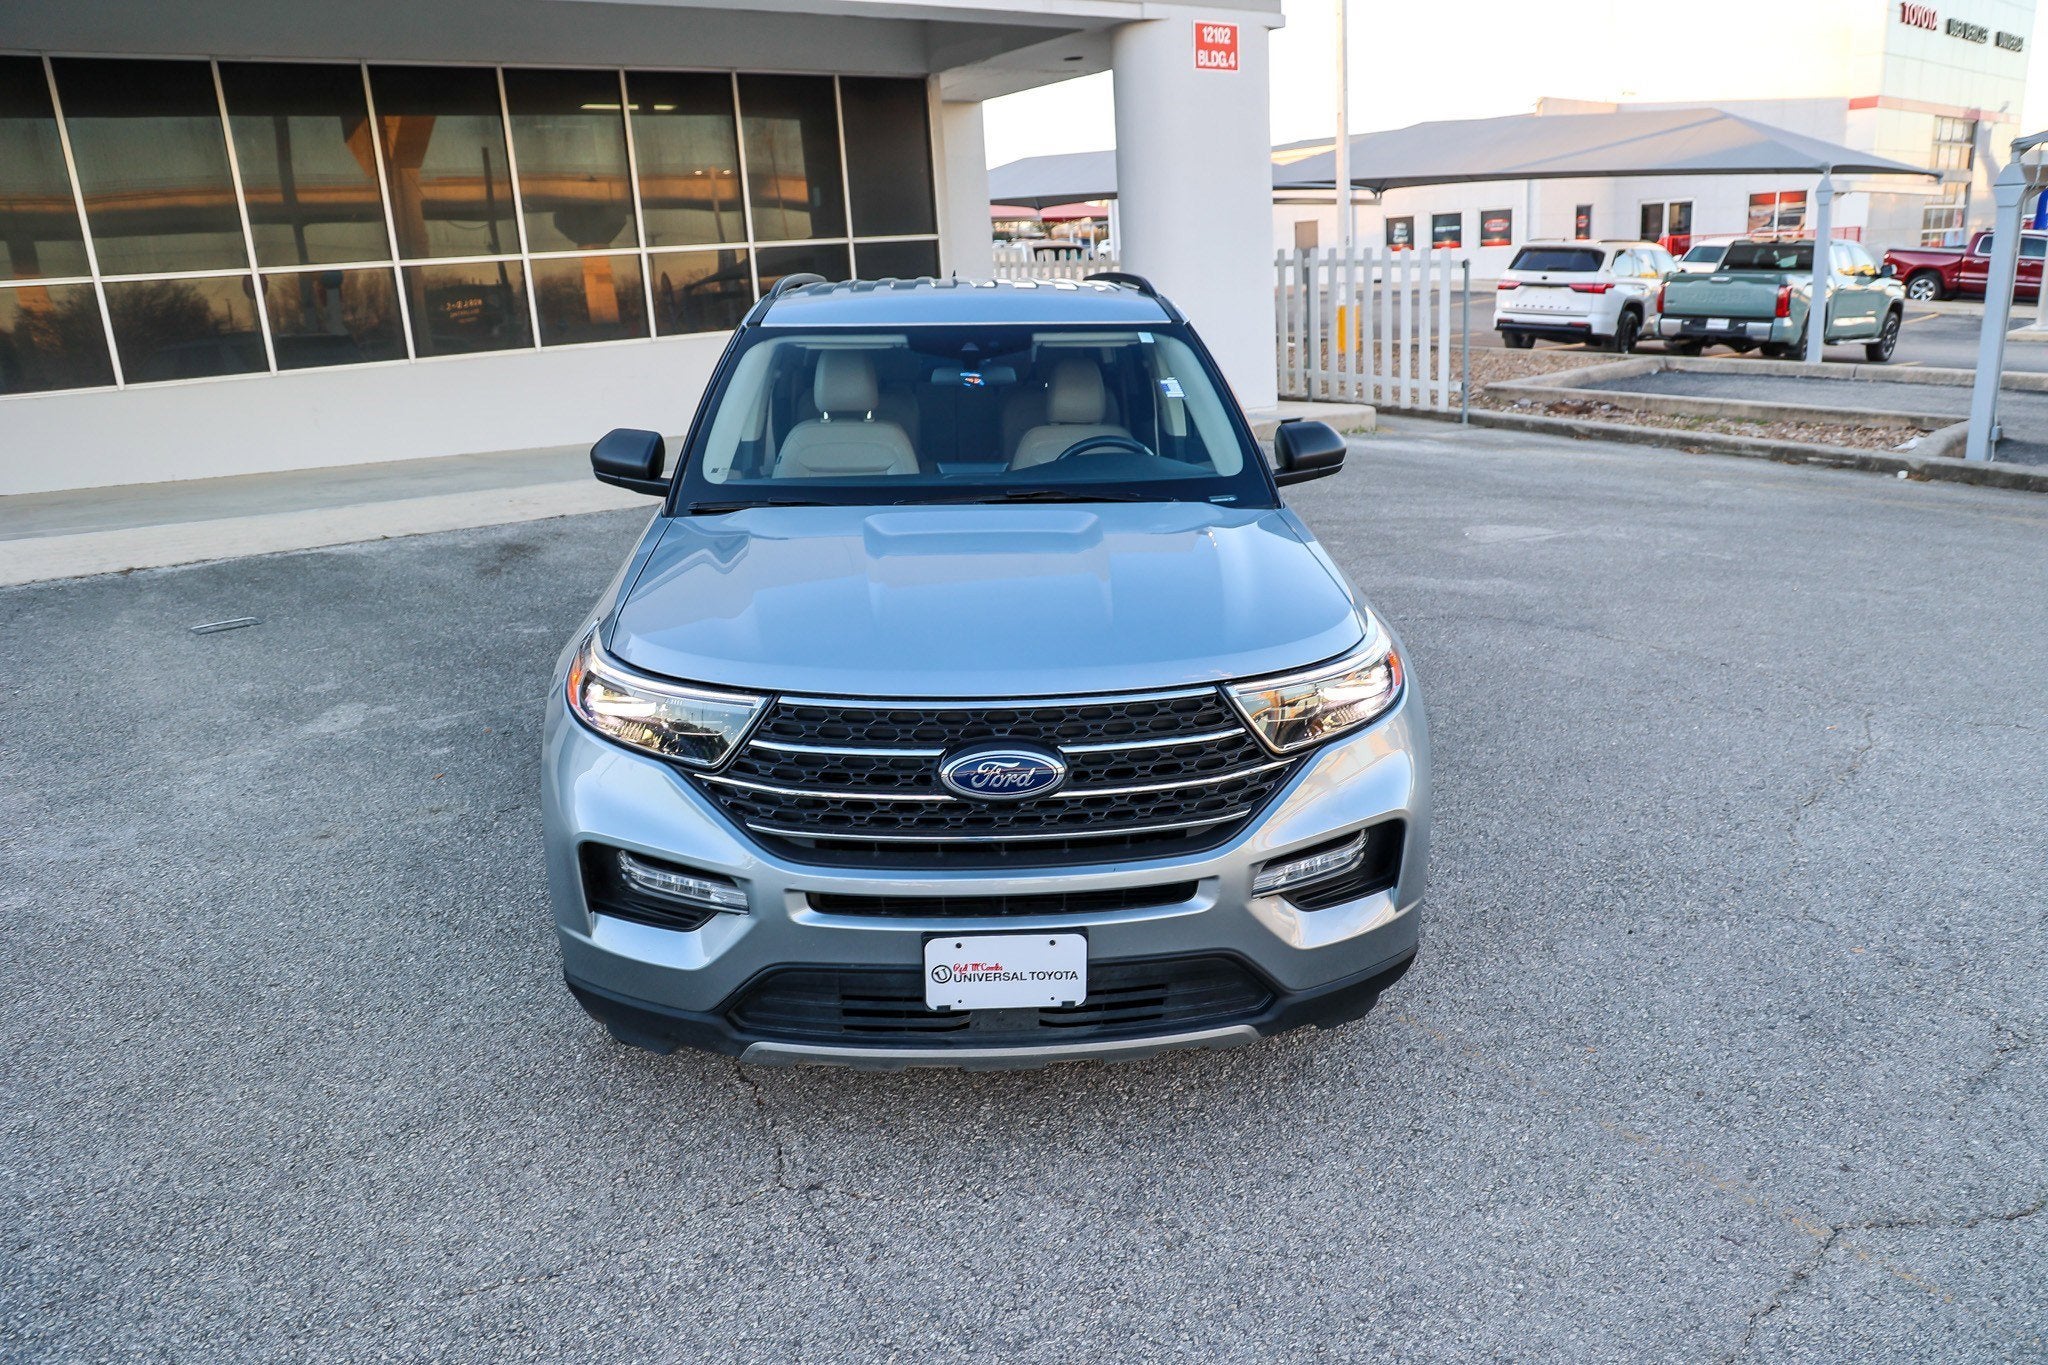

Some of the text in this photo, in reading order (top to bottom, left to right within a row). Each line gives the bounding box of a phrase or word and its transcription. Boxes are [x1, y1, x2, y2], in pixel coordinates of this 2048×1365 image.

[1900, 2, 1937, 30] TOYOTA
[1202, 26, 1231, 44] 12102
[971, 761, 1035, 788] Ford
[954, 970, 1079, 983] UNIVERSAL TOYOTA
